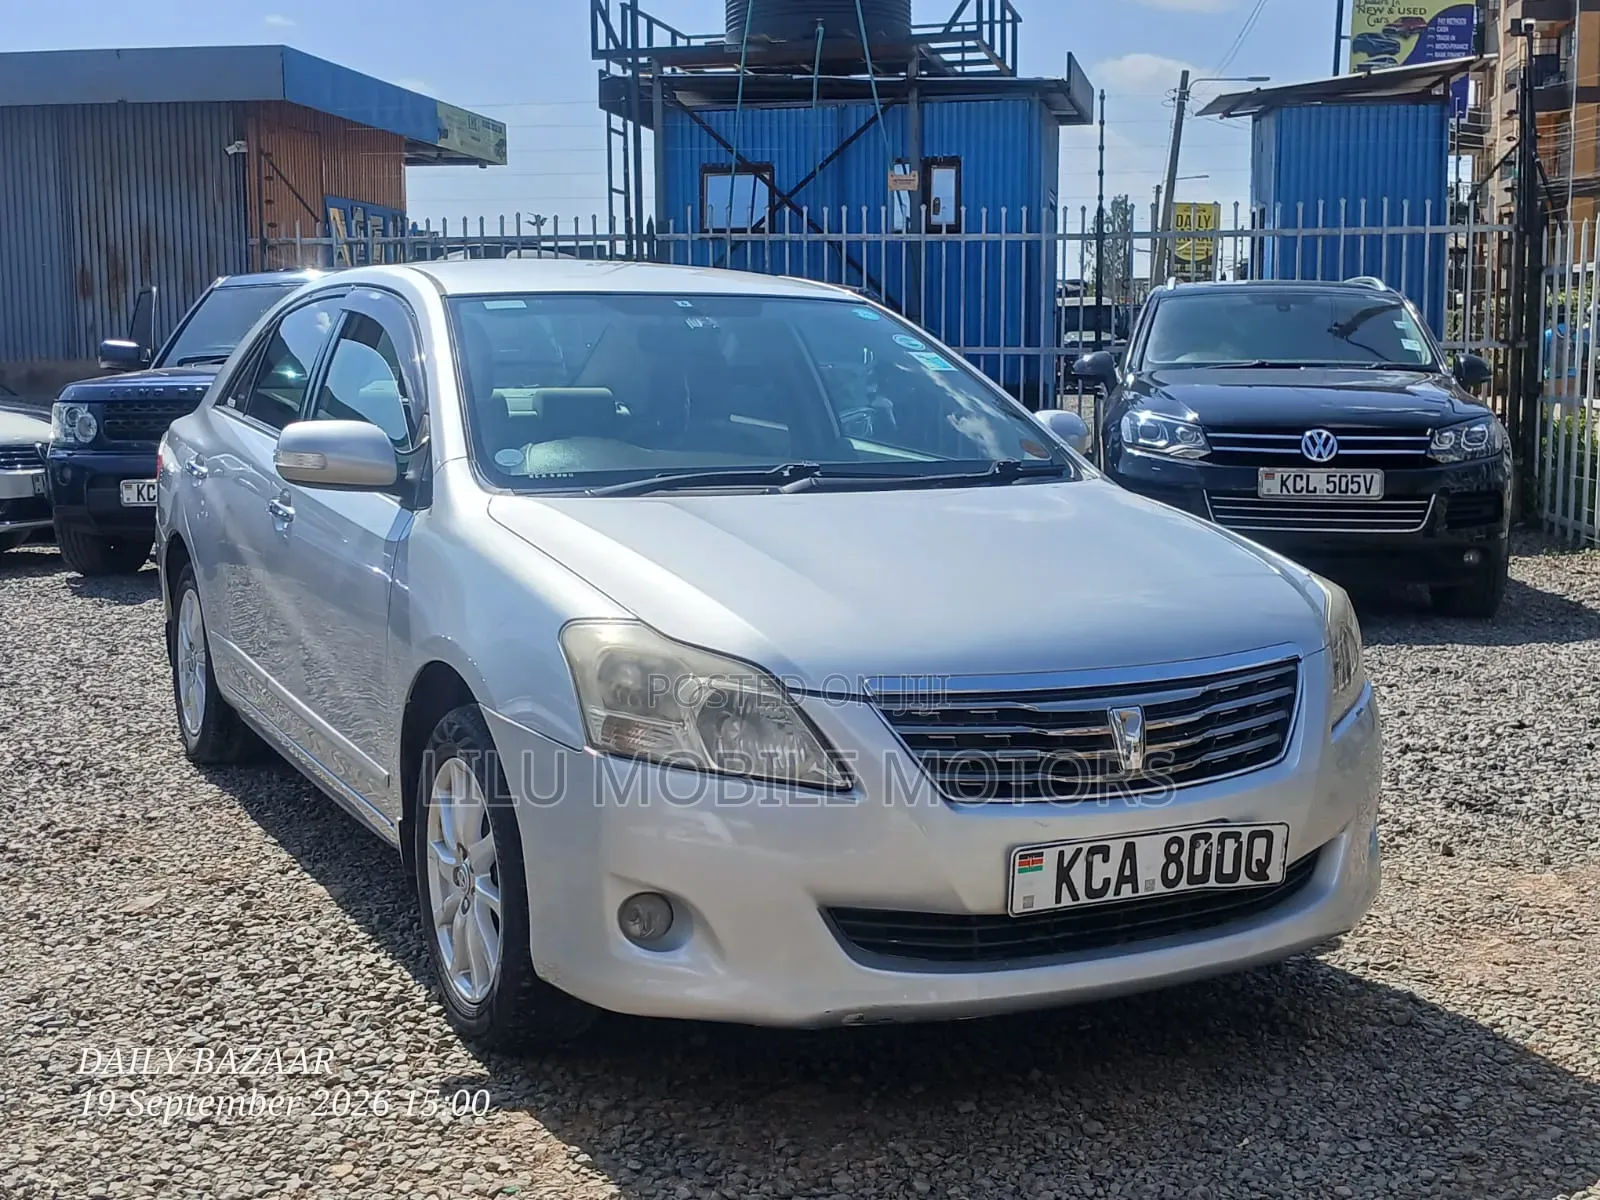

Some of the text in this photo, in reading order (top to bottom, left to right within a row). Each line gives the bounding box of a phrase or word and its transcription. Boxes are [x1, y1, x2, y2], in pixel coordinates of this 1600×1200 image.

[1358, 6, 1427, 16] NEW & USED
[1366, 13, 1390, 27] Cars
[1176, 214, 1211, 228] DALY
[1280, 474, 1374, 494] KCL 505V
[1054, 841, 1139, 905] KCA
[1161, 829, 1274, 889] 800Q
